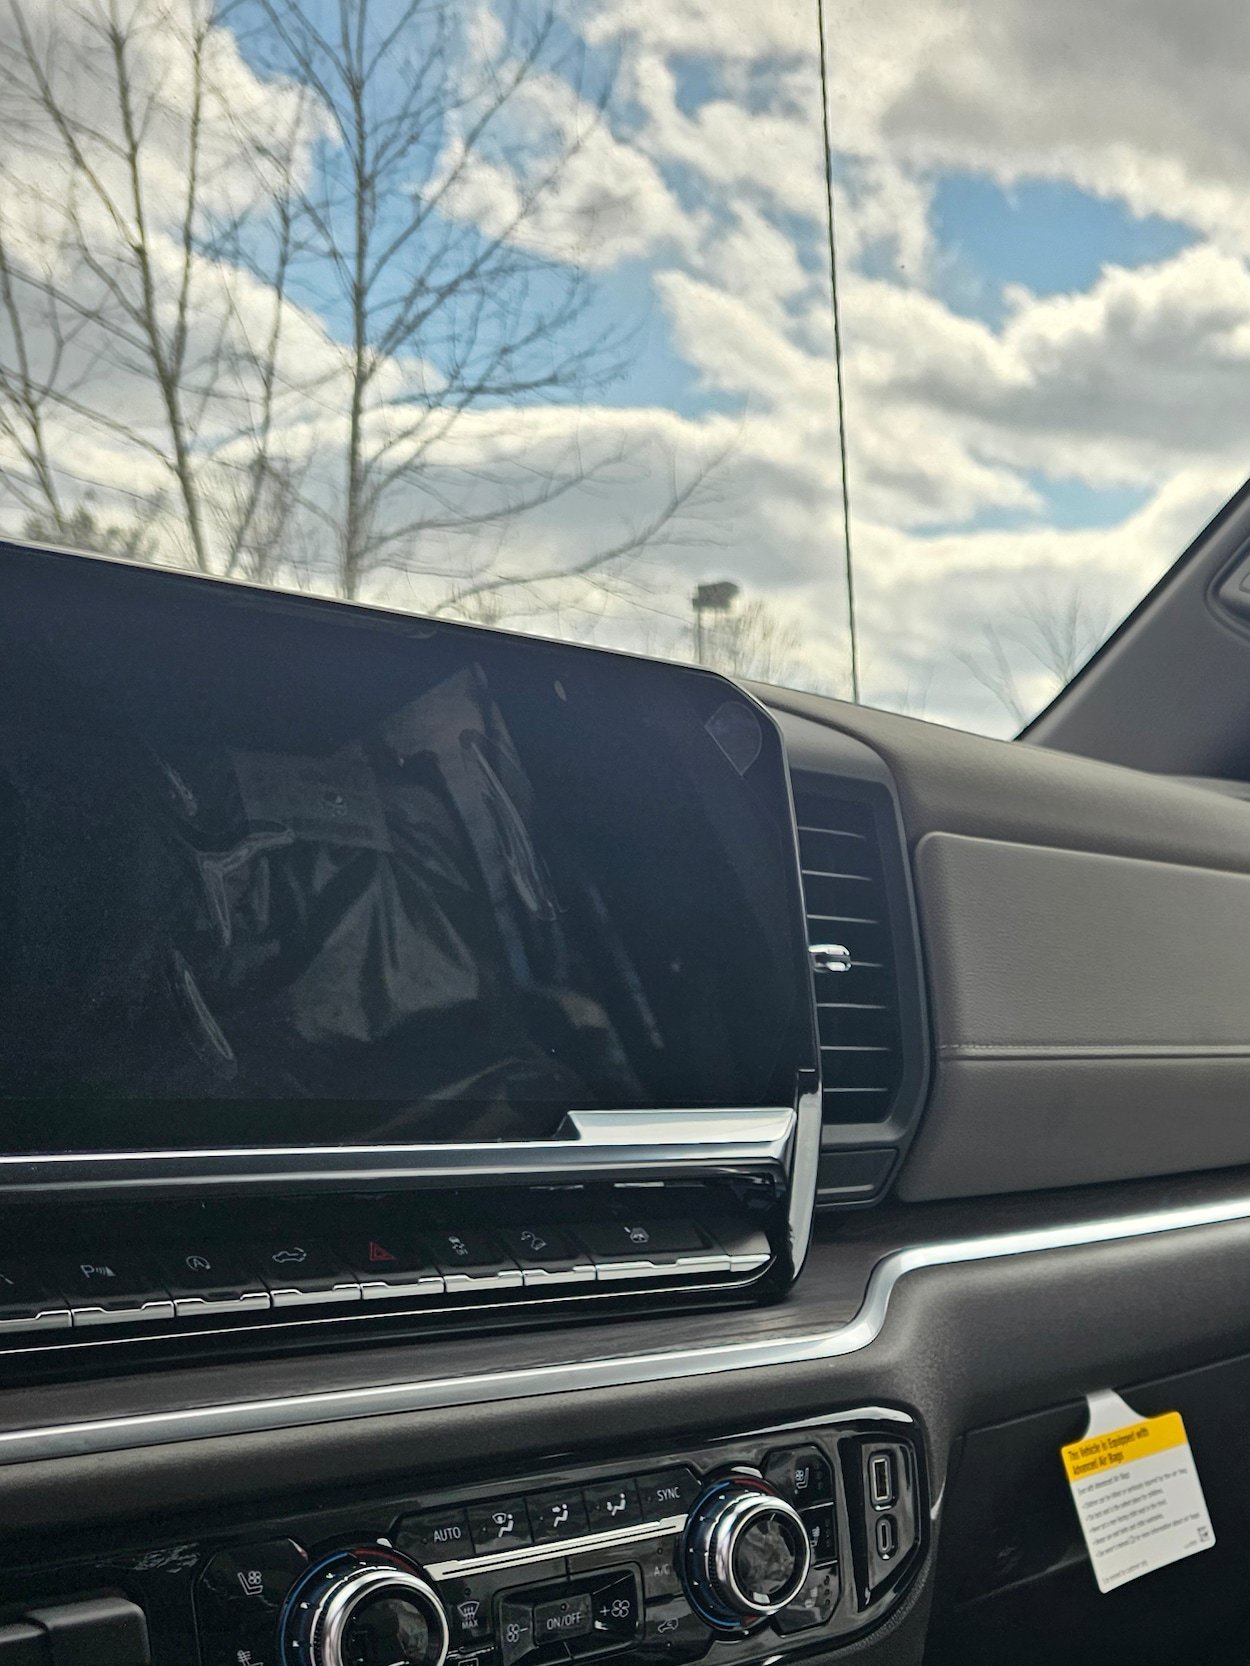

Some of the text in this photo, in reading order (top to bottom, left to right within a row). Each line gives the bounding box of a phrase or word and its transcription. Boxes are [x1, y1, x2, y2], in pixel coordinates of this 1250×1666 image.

[656, 1486, 680, 1502] SYNC
[433, 1526, 462, 1543] AUTO
[653, 1563, 670, 1577] A/C
[461, 1619, 478, 1630] MAX
[546, 1611, 583, 1630] ON/OFF
